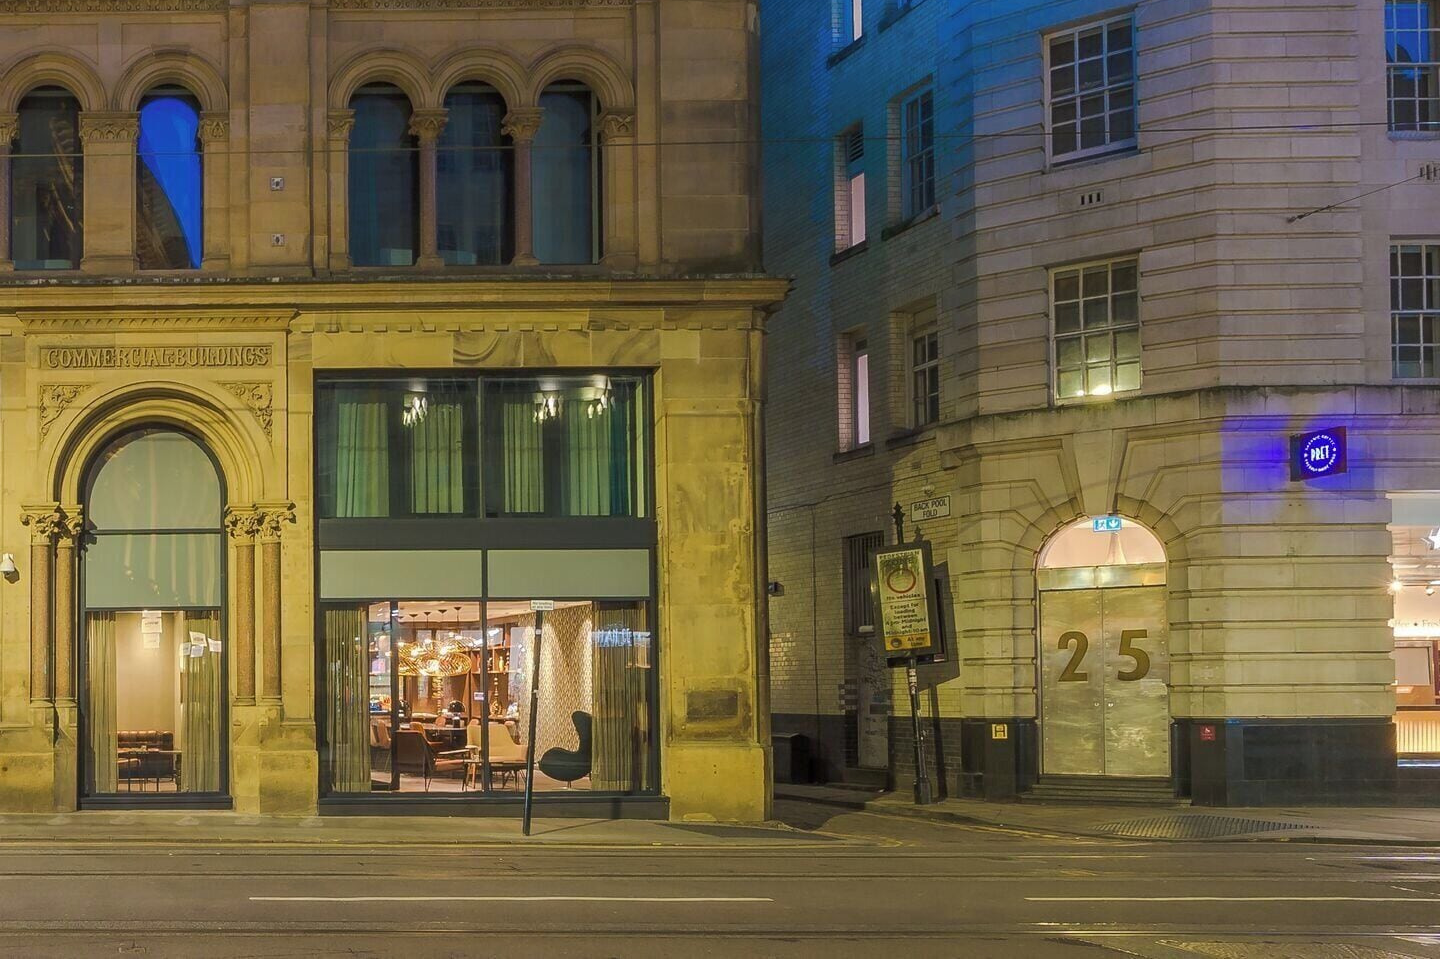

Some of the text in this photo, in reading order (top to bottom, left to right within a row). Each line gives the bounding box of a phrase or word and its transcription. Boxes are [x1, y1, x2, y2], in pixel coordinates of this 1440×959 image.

[47, 346, 270, 369] COMMERCIAL BUILDINGS
[1310, 444, 1330, 462] PRET
[914, 498, 947, 512] BACK POOL
[923, 509, 937, 518] FOLD
